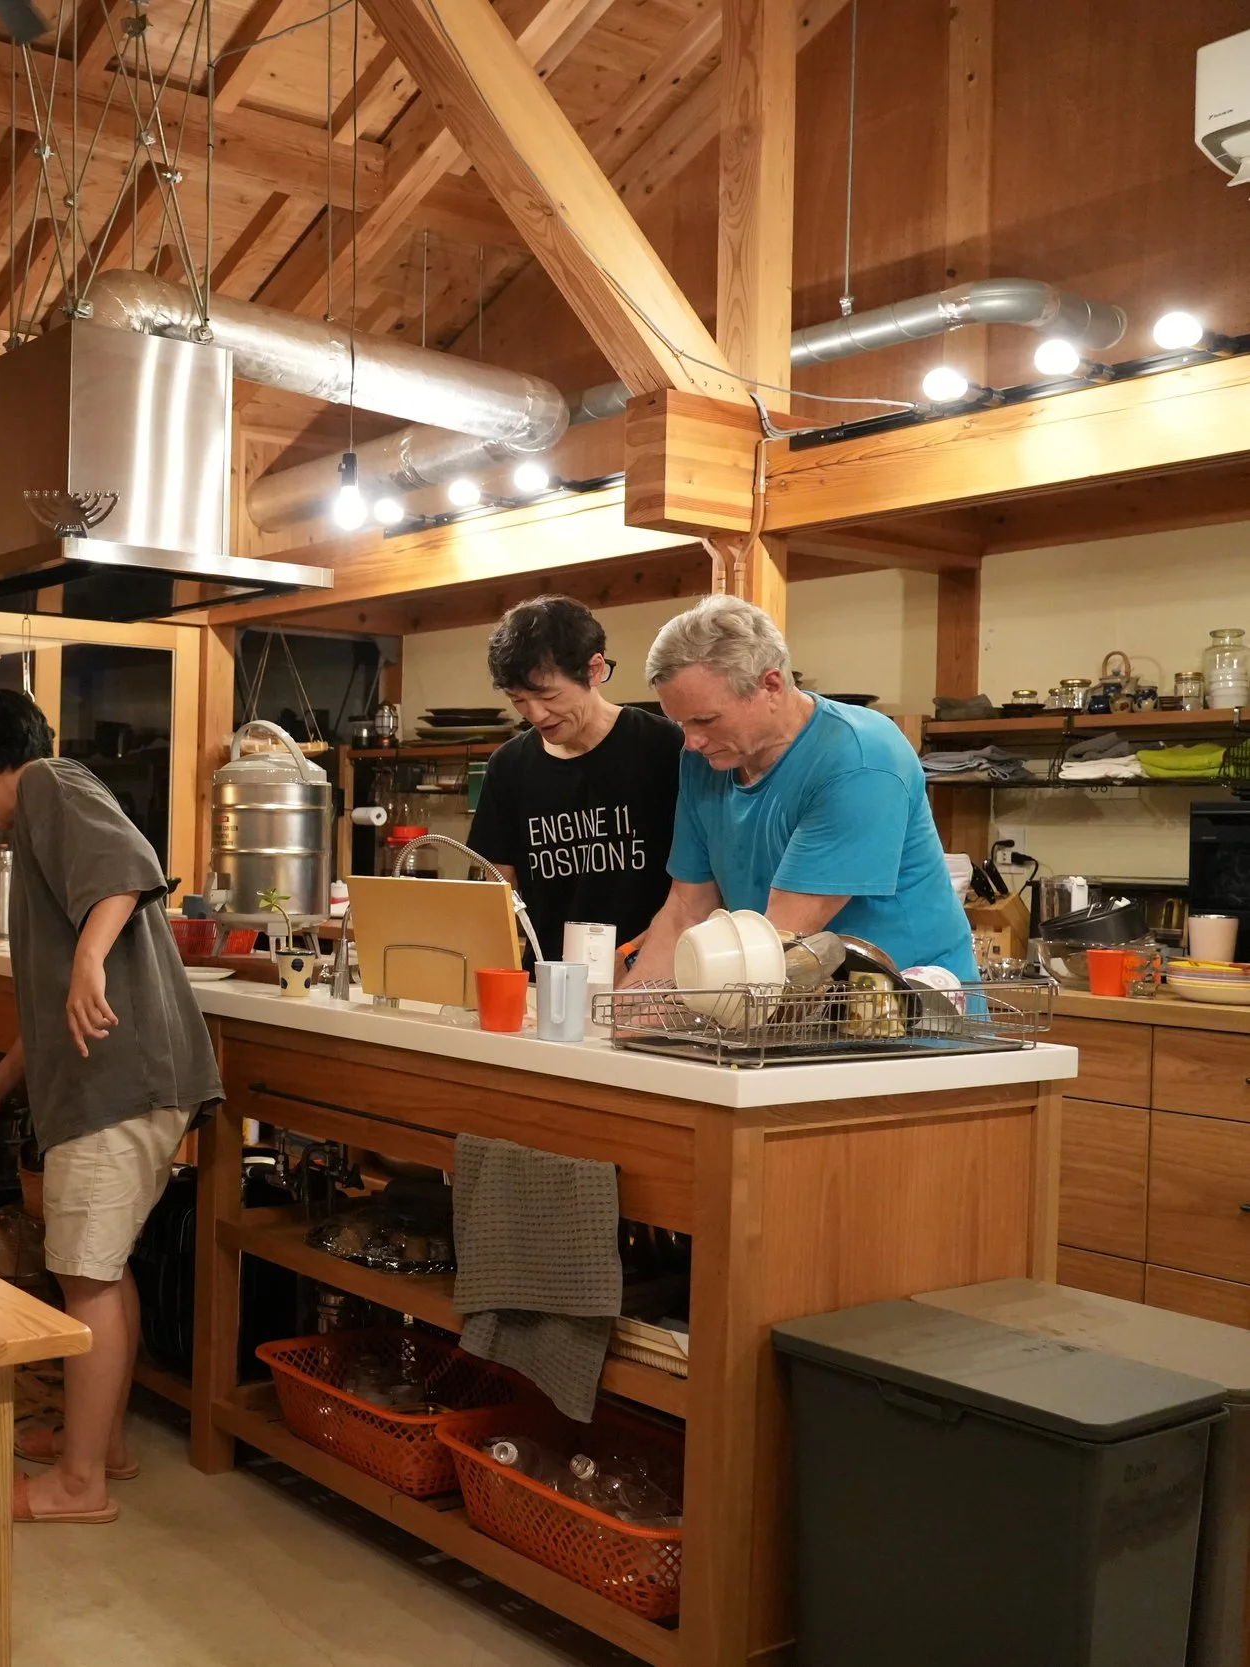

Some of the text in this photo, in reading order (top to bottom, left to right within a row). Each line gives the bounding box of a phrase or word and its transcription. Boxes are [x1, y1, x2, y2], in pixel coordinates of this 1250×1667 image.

[528, 804, 636, 846] ENGINE 11,
[528, 839, 646, 881] POSITION 5
